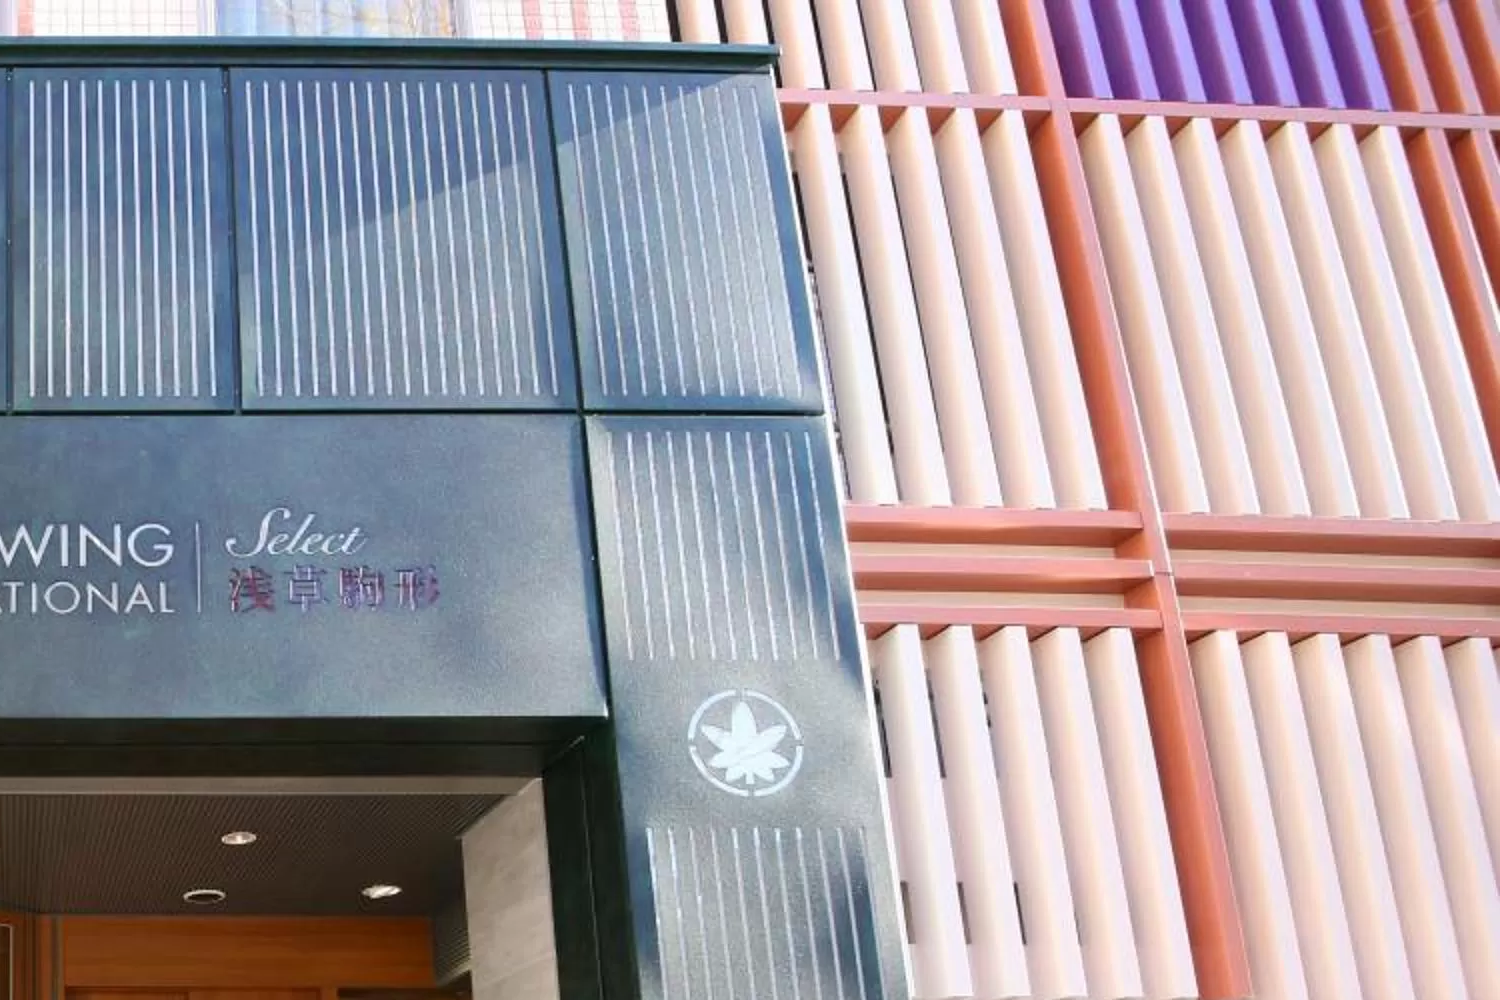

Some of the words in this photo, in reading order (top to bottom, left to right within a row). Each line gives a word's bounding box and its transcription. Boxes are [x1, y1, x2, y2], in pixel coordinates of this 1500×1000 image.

[225, 507, 368, 557] Select
[228, 564, 441, 613] 浅草駒形
